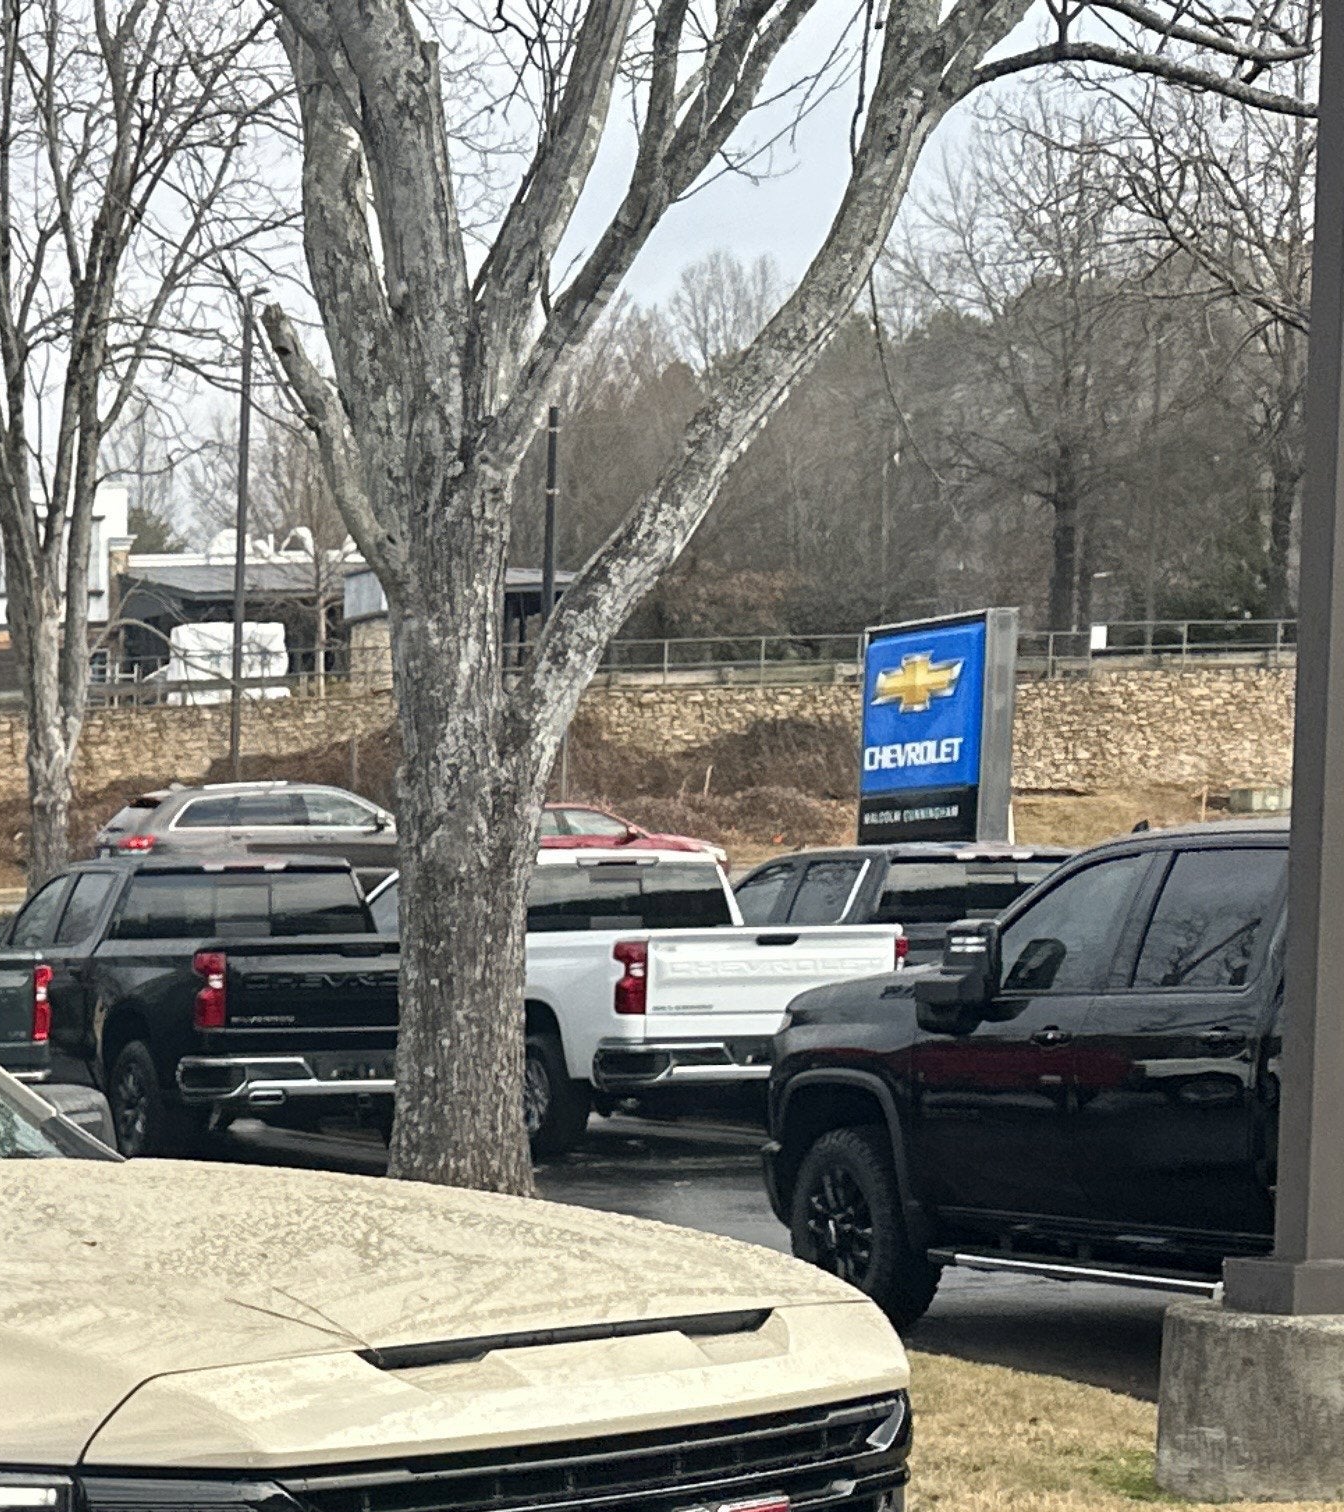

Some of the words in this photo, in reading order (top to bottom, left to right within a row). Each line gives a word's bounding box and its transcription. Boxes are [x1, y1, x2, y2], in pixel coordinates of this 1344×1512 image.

[864, 737, 964, 771] CHEVROLET
[864, 810, 902, 824] MALCOLM
[903, 805, 959, 822] CUNNINGHAM
